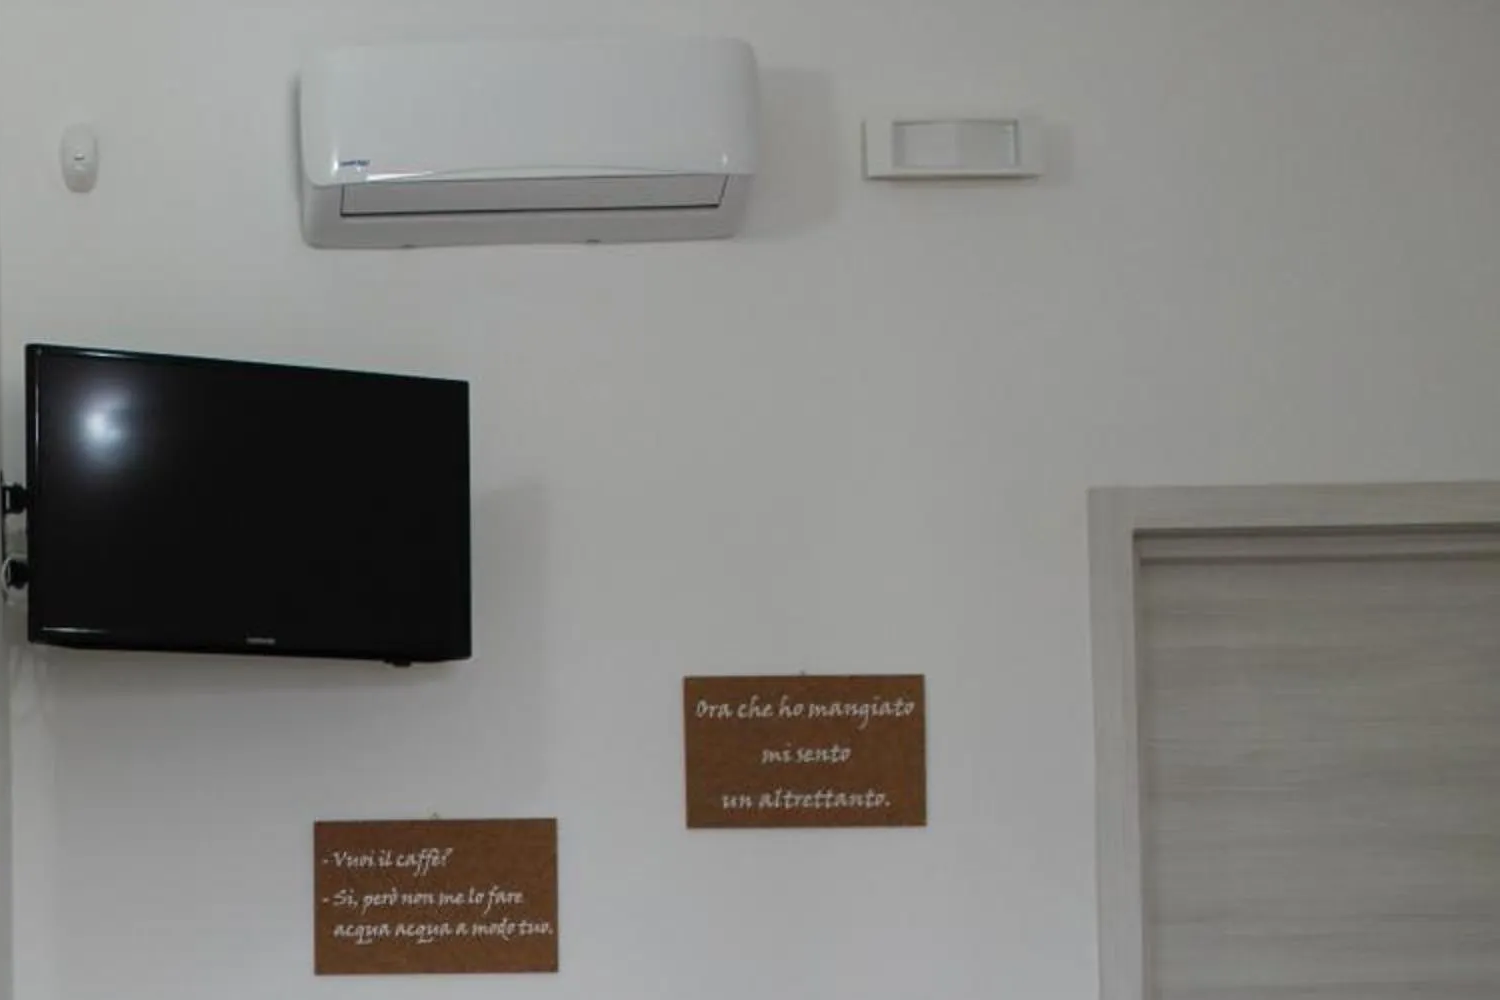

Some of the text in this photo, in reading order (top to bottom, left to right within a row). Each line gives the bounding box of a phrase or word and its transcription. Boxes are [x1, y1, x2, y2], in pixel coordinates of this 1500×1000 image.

[695, 694, 916, 730] Ora che ho mangiato
[761, 742, 852, 764] mi sento
[721, 787, 892, 809] un altrettanto.
[333, 849, 374, 868] Vuoi
[378, 849, 393, 868] il
[401, 891, 434, 905] non
[439, 891, 465, 906] me
[468, 887, 485, 905] lo
[484, 884, 524, 914] fare
[333, 917, 554, 945] acqua acqua a modo tuo.
